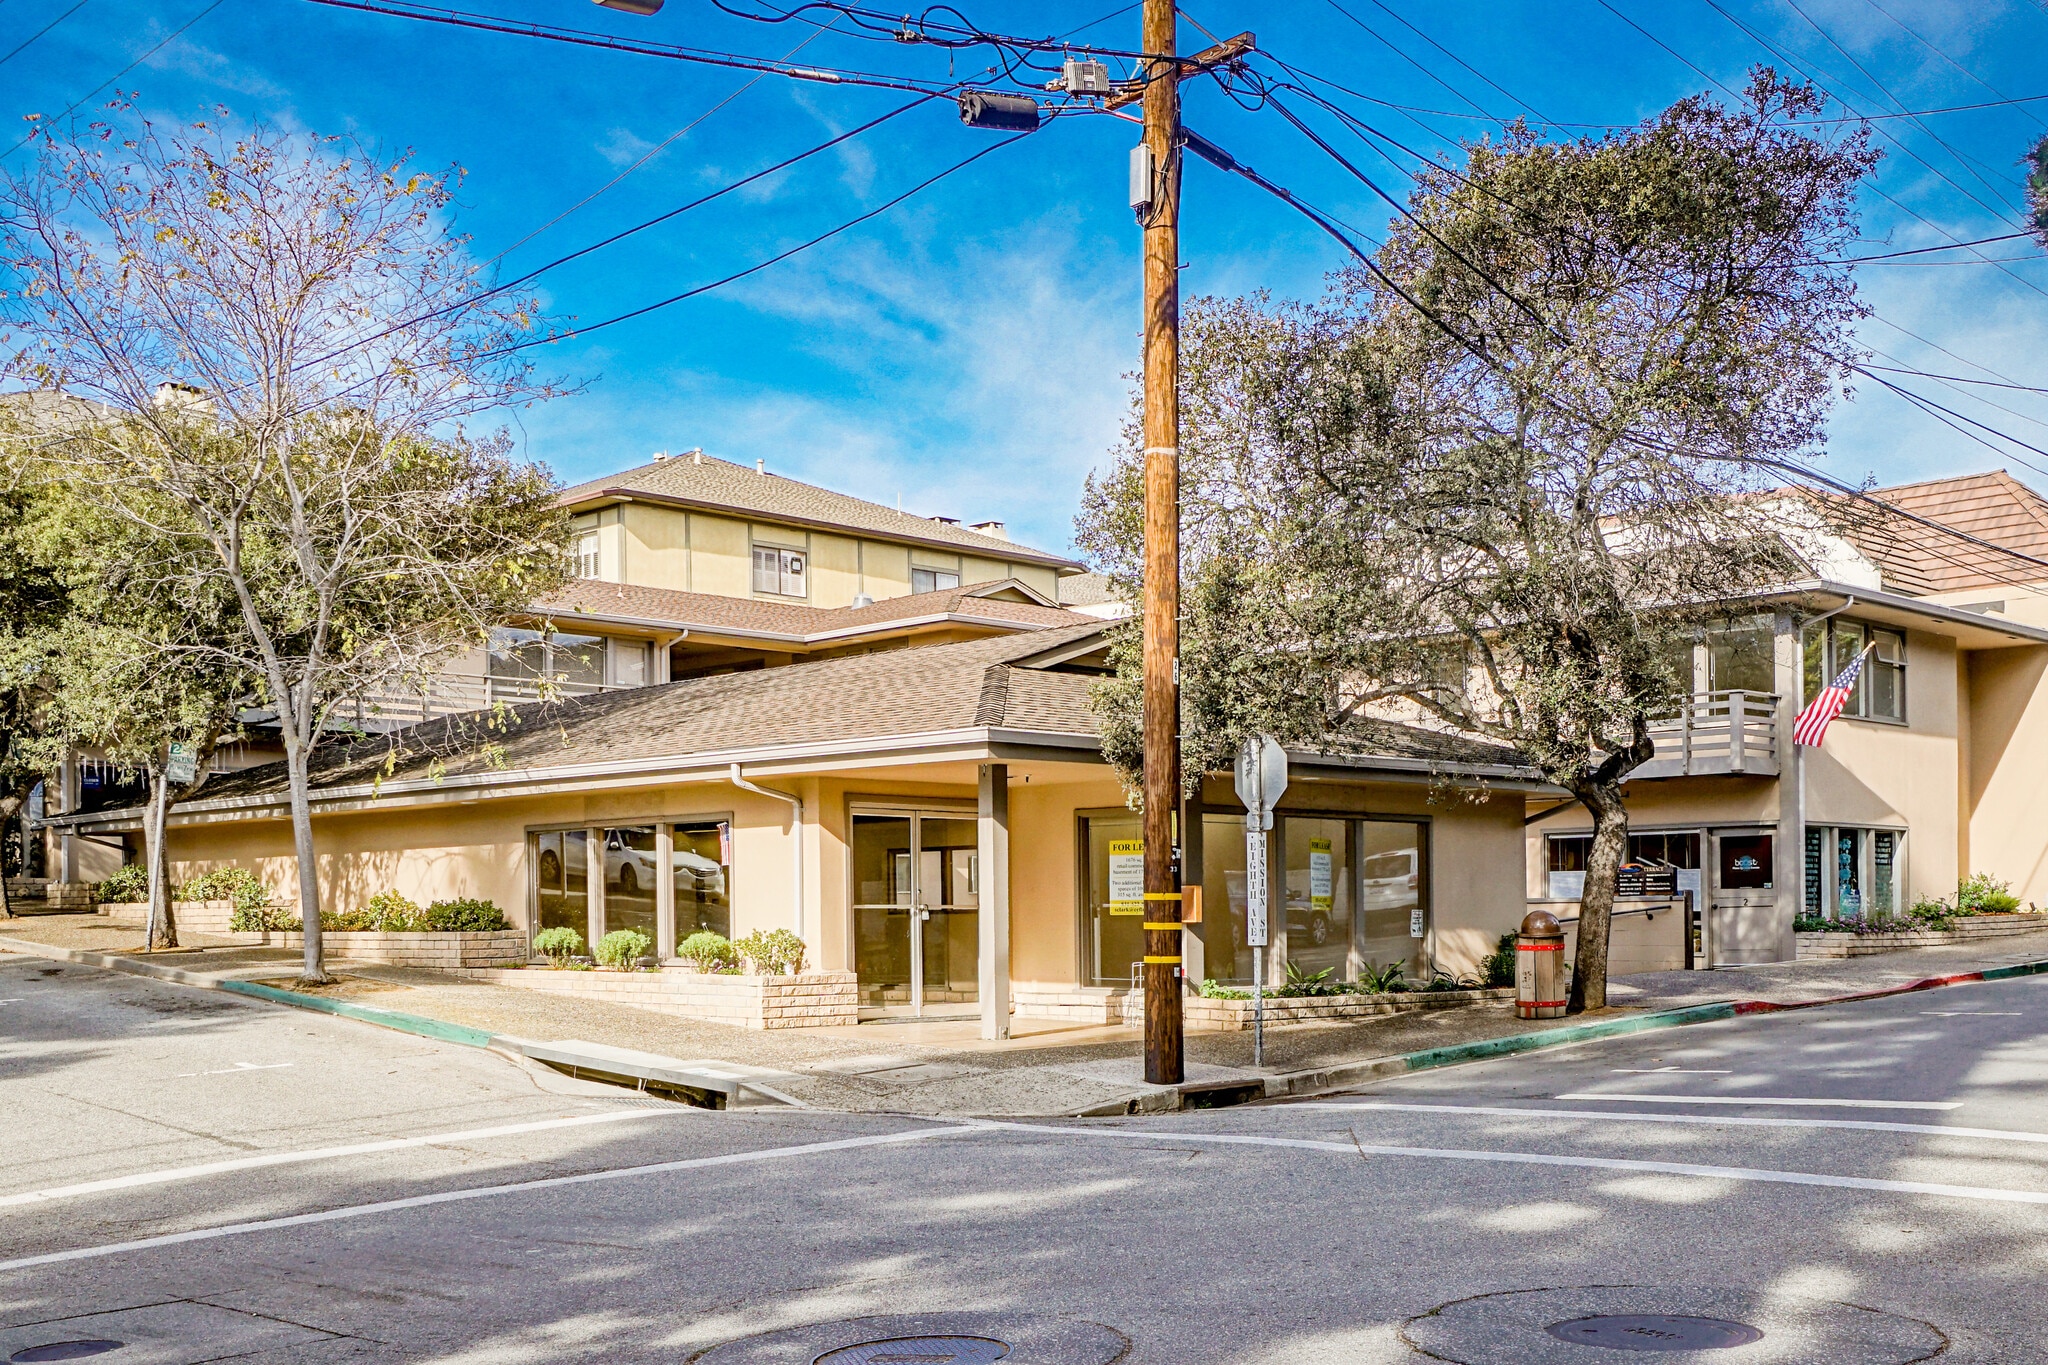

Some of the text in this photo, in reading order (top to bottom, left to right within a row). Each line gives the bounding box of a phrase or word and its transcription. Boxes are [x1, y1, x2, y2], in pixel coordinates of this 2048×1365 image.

[172, 743, 181, 754] 2
[1113, 843, 1131, 851] FOR
[1734, 858, 1758, 867] boost
[1249, 842, 1257, 900] EIGHTH
[1259, 919, 1266, 938] ST
